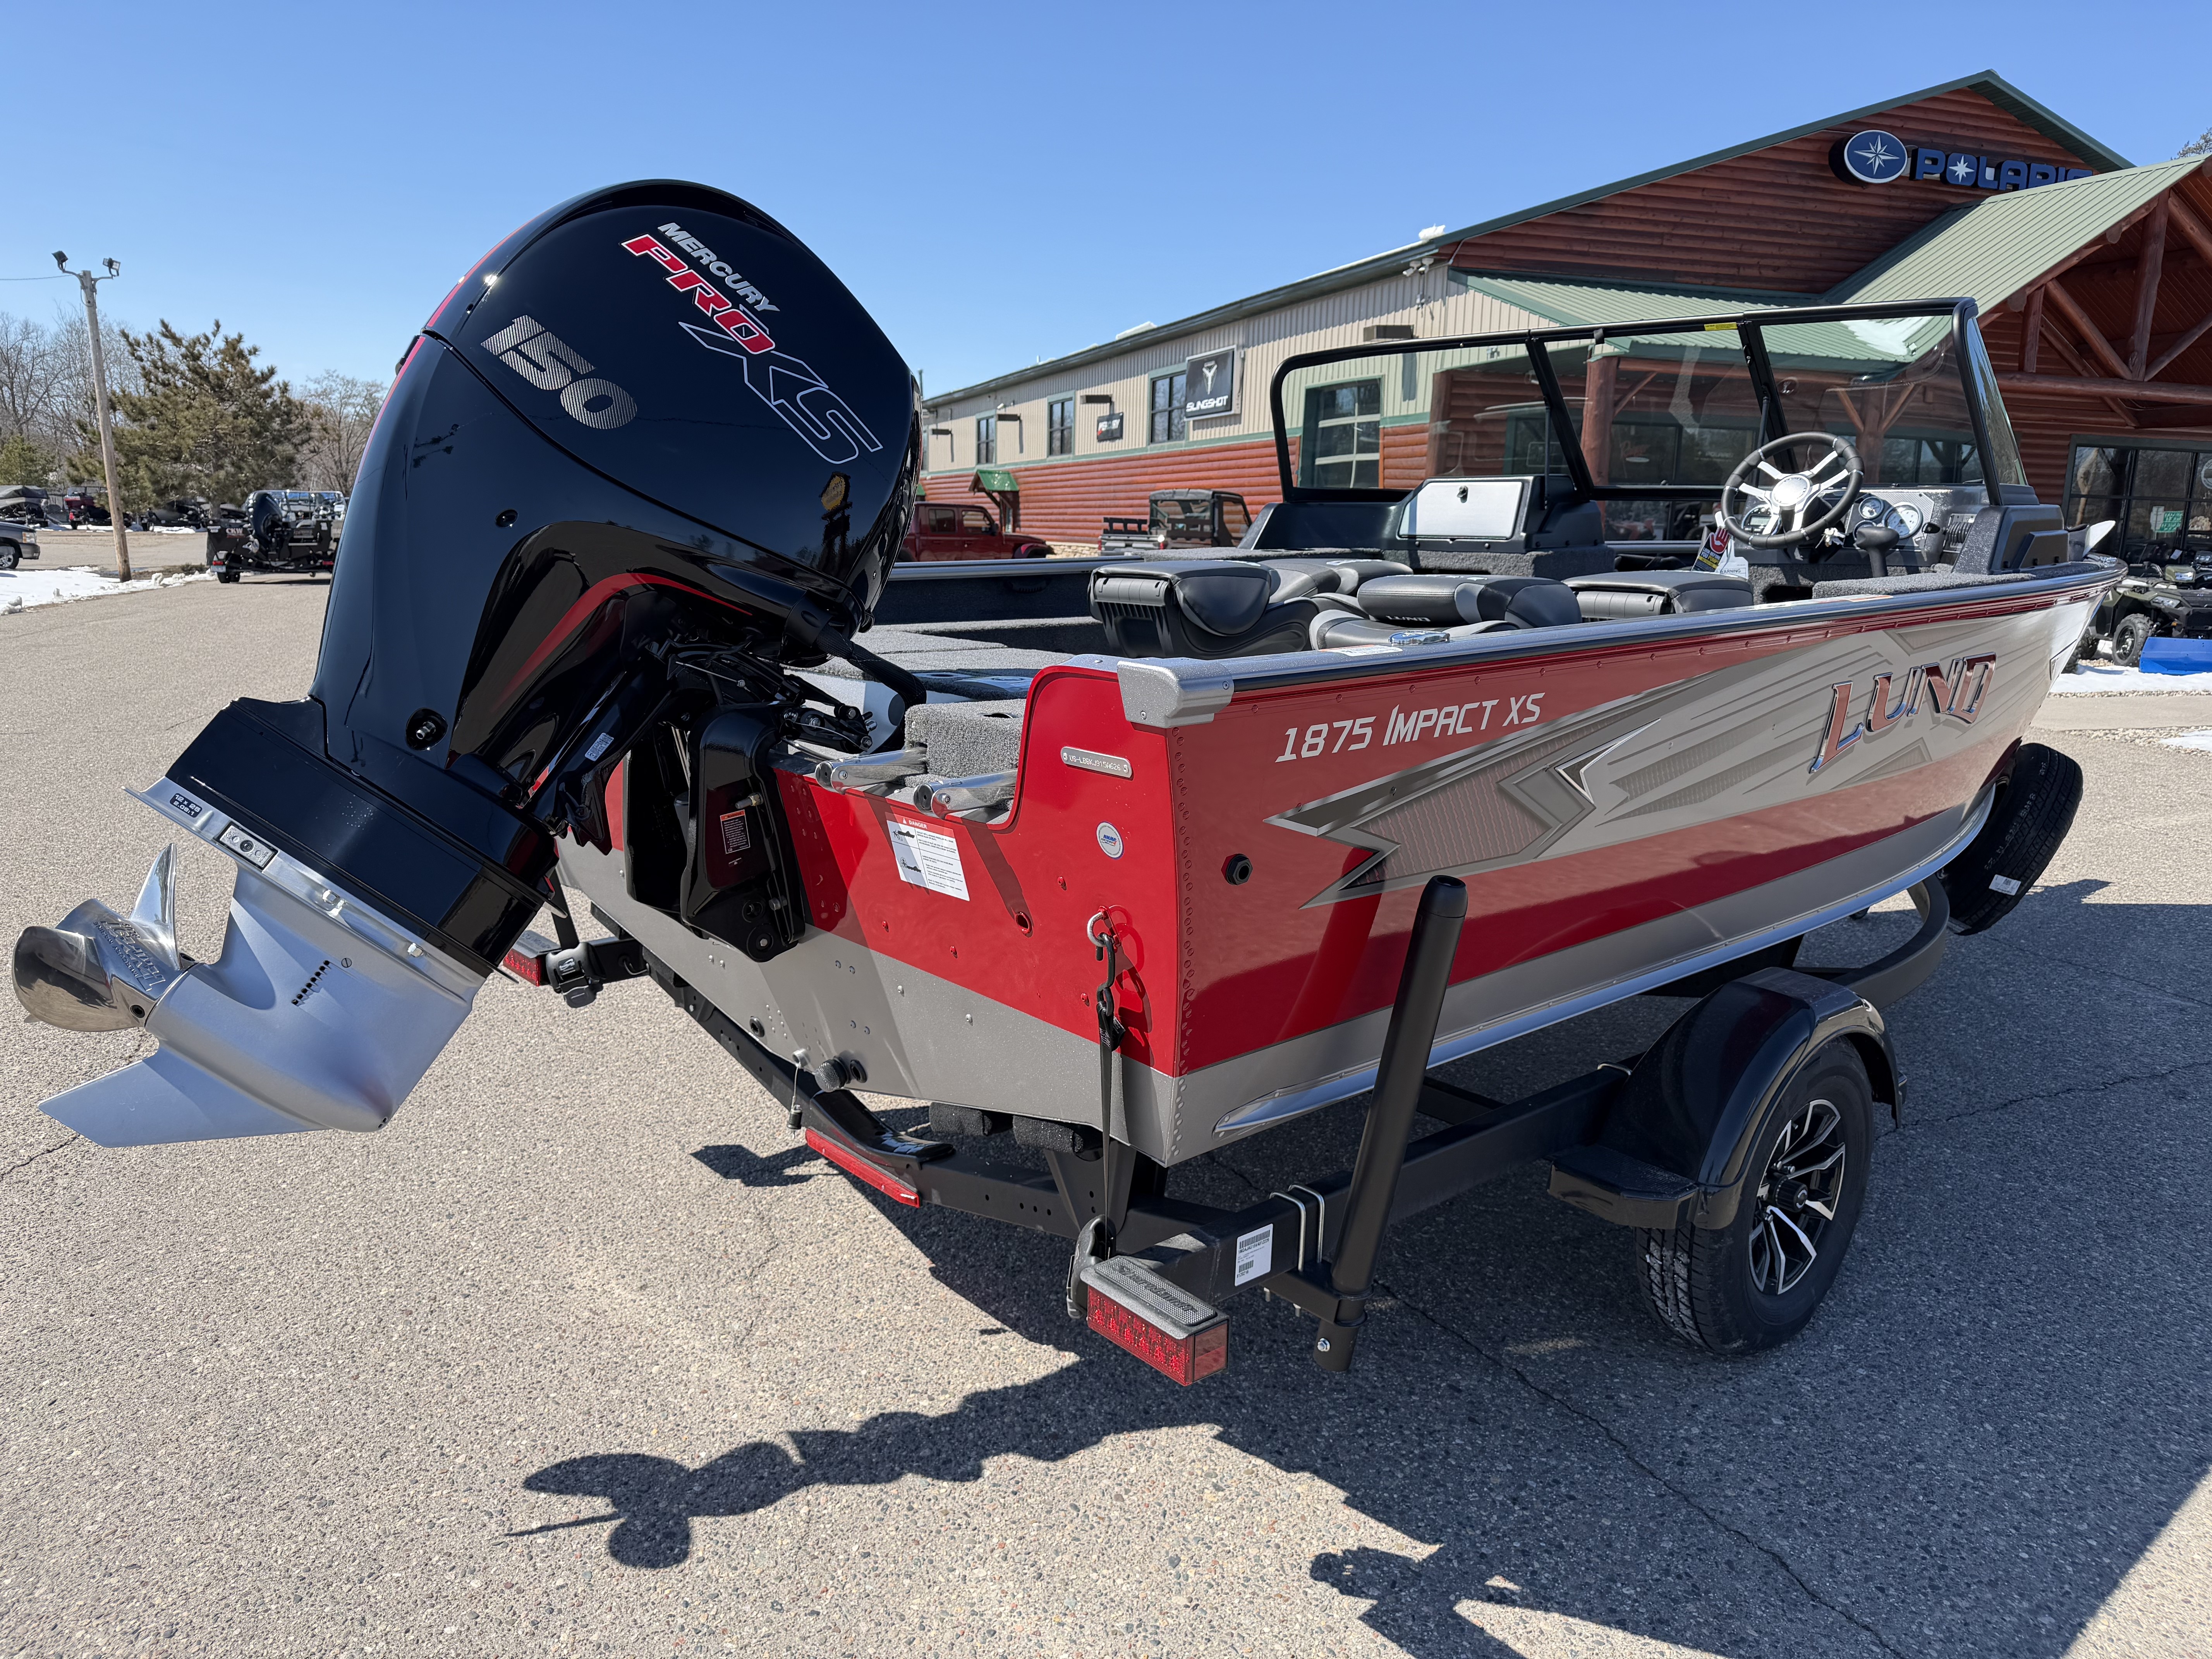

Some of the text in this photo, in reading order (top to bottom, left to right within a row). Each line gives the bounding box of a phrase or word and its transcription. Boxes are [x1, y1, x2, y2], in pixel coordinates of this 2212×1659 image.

[621, 234, 776, 355] PRO
[658, 222, 780, 312] MERCURY
[481, 314, 638, 429] 150
[678, 304, 883, 464] XS
[1186, 395, 1228, 412] SLINGSHOT
[1275, 692, 1545, 763] 1875 IMPACT XS
[1808, 651, 1997, 774] LUND
[173, 801, 194, 816] 2.08:1
[175, 794, 184, 802] 12
[908, 820, 927, 829] DANGER
[93, 921, 139, 977] MERCURY MARINE
[122, 923, 141, 939] PLUS
